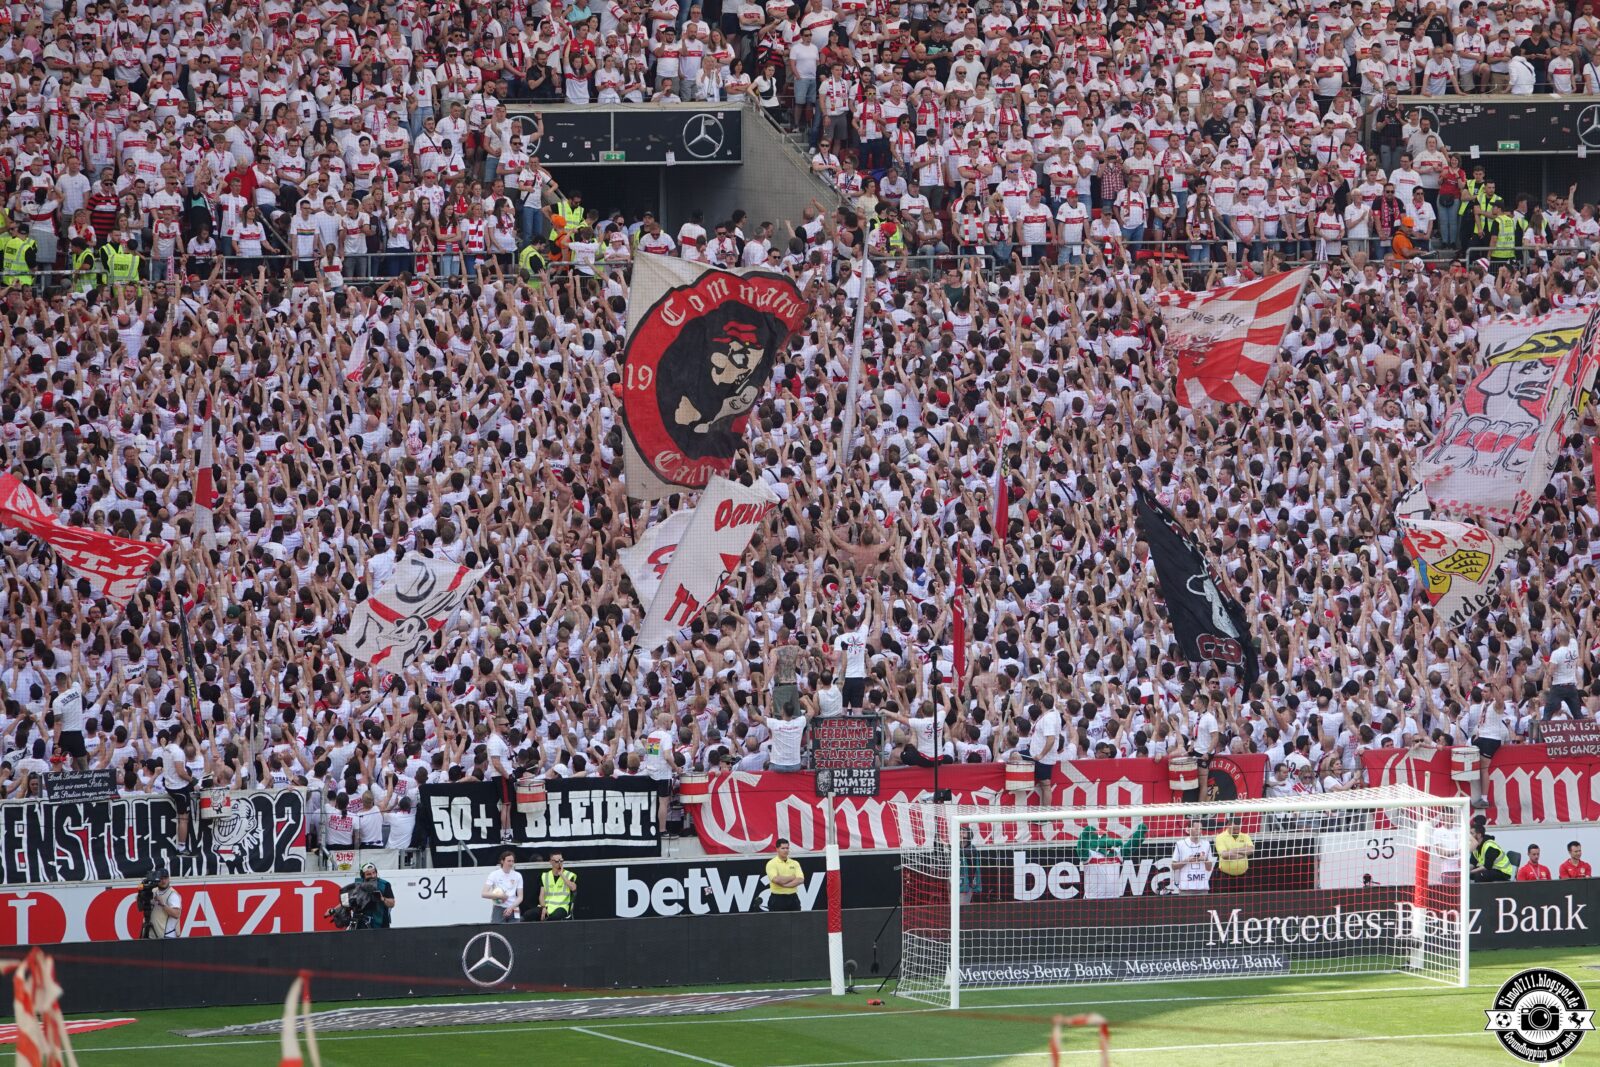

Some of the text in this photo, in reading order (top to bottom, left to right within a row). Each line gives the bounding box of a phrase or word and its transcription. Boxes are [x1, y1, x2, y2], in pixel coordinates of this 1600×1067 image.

[661, 277, 800, 327] Comman
[627, 363, 653, 391] 19
[814, 727, 874, 739] VERBANNTE
[821, 718, 867, 728] JEDER
[1540, 722, 1576, 733] ULTRA
[820, 739, 868, 749] KEHRT
[1544, 735, 1566, 743] DER
[1547, 746, 1569, 756] UMS
[833, 769, 876, 778] DU BIST
[833, 777, 876, 787] IMMER
[430, 789, 658, 842] 50+ BLEIBT!
[698, 760, 1145, 856] Commando
[0, 789, 305, 887] ENSTURM 02
[1366, 837, 1395, 860] 35
[1014, 851, 1218, 901] bewa
[1186, 873, 1206, 881] SMF
[418, 875, 448, 900] 34
[1206, 894, 1589, 947] Mercedes-Benz Bank
[958, 961, 1114, 983] Mercedes-Benz Bank
[1125, 952, 1284, 975] Mercedes-Benz Bank
